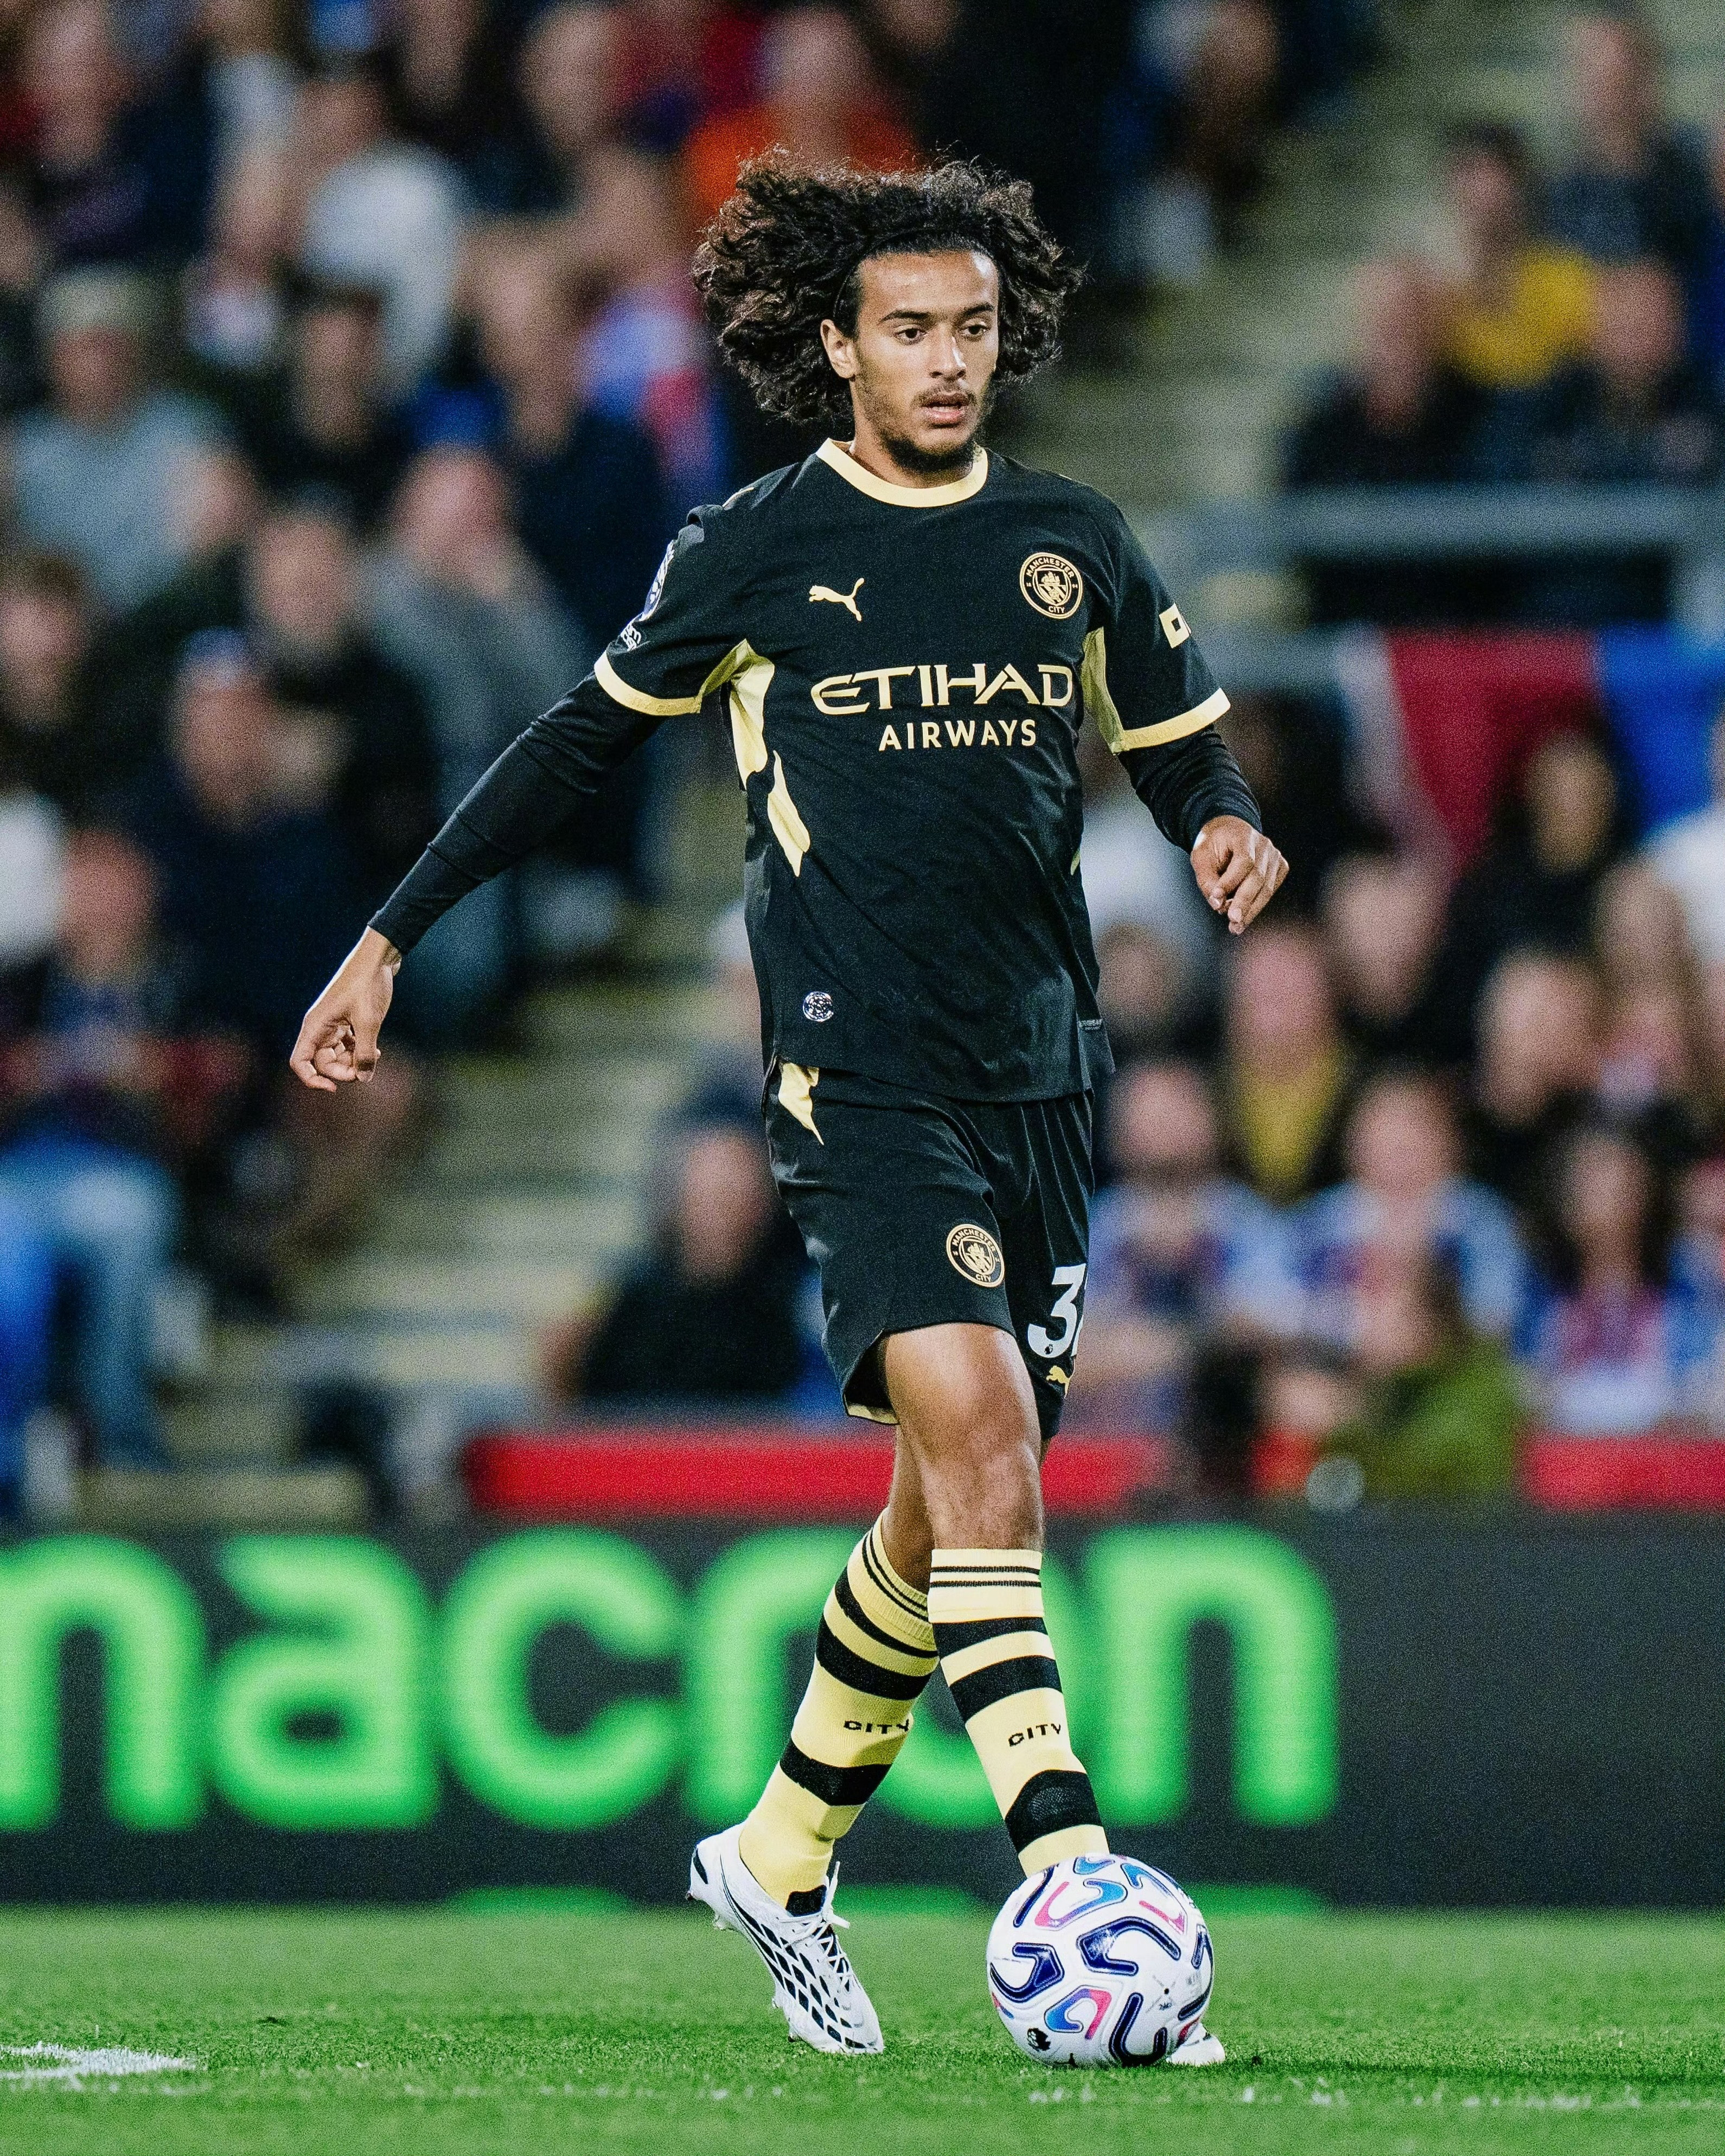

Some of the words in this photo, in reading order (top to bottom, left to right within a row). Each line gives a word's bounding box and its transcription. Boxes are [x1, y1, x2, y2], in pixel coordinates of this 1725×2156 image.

[1025, 556, 1075, 578] MANCHESTER
[1048, 605, 1065, 613] CITY
[810, 663, 1073, 715] ETIHAD
[878, 719, 1036, 751] AIRWAYS
[951, 1228, 996, 1252] MANCHESTER
[975, 1272, 992, 1283] CITY
[1027, 1263, 1088, 1358] 3
[844, 1718, 910, 1735] CITY
[1008, 1723, 1062, 1747] CITY
